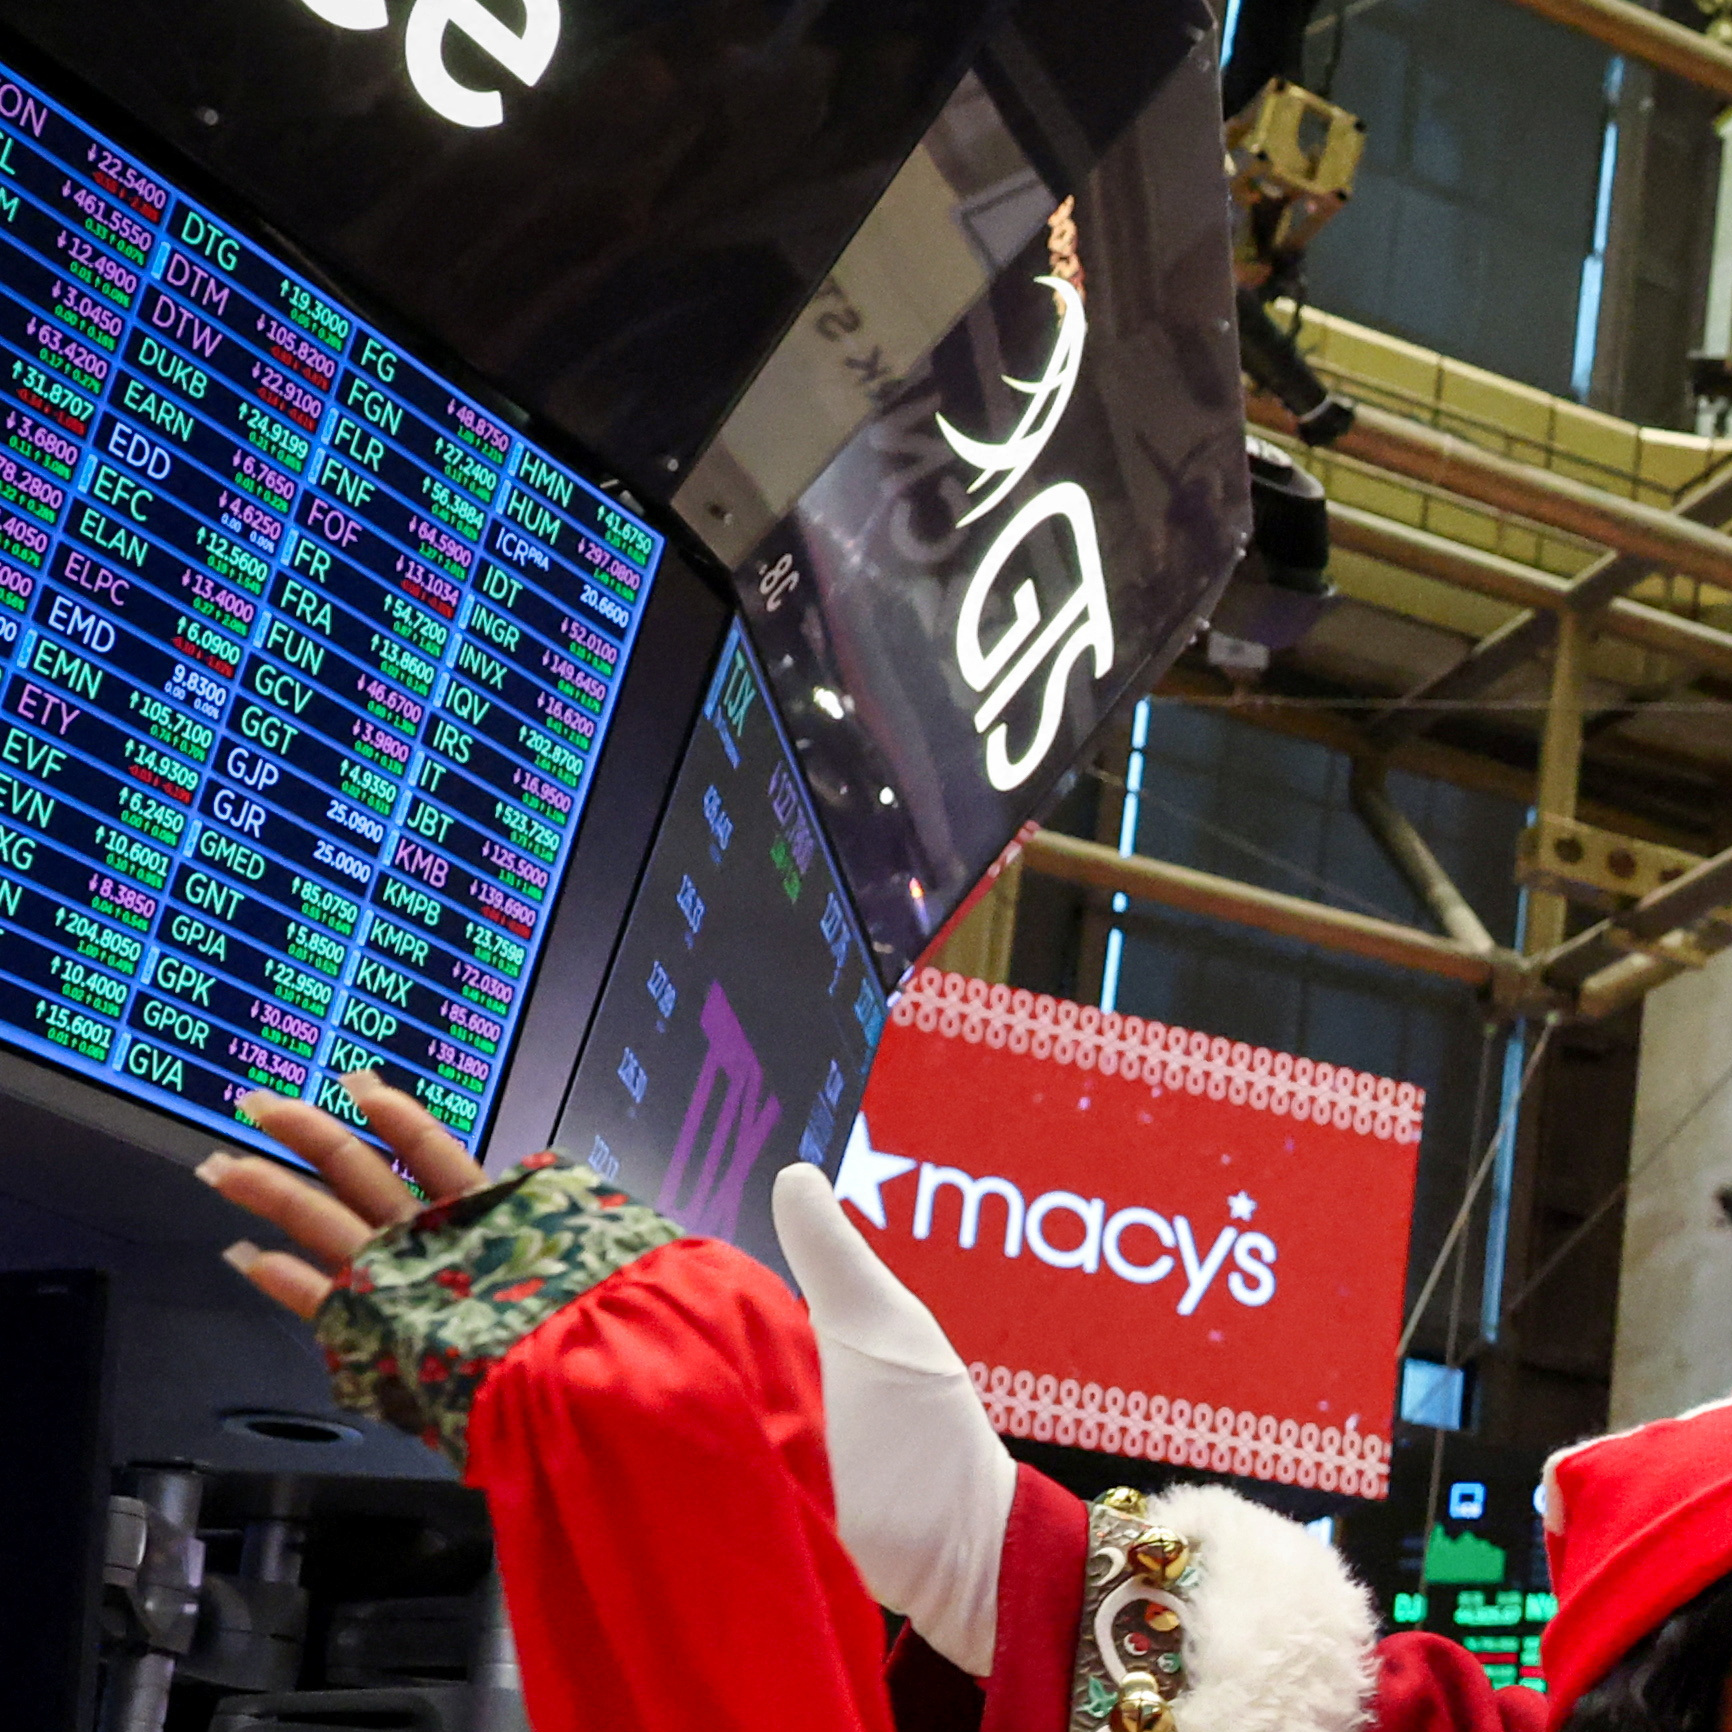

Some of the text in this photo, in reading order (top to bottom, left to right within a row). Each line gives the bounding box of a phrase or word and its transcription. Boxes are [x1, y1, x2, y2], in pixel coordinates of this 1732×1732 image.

[0, 82, 166, 209] ON 22.5400
[68, 237, 137, 294] 12.4900
[73, 189, 151, 251] 461.5550
[63, 286, 122, 336] 3.0450
[166, 253, 335, 378] DTM 105.8200
[181, 211, 349, 339] DTG 19.3000
[22, 366, 94, 421] 31.8707
[38, 325, 107, 379] 63.4200
[152, 295, 322, 419] DTW 22.9100
[360, 338, 509, 452] FG 48.8750
[18, 416, 78, 466] 3.6800
[124, 379, 295, 500] EARN 6.7650
[138, 337, 309, 459] DUKB 24.9199
[347, 378, 497, 491] FGN 27.2400
[109, 422, 281, 540] EDD 4.6250
[321, 458, 472, 567] FNF 64.5900
[334, 417, 485, 530] FLR 56.3884
[507, 489, 561, 545] HUM
[519, 451, 574, 508] HMN
[79, 508, 254, 623] ELAN 13.4000
[93, 465, 268, 582] EFC 12.5600
[307, 498, 459, 607] FOF 13.1034
[64, 551, 129, 606] ELPC
[187, 622, 241, 665] 6.0900
[280, 579, 435, 685] FRA 13.8600
[294, 538, 448, 645] FR 54.7200
[471, 604, 520, 652] INGR
[482, 565, 523, 608] IDT
[33, 639, 213, 749] EMN 105.7100
[48, 595, 115, 652] EMD
[172, 664, 226, 706] 9.8300
[267, 620, 422, 723] FUN 46.6700
[458, 642, 508, 689] INVX
[17, 683, 199, 791] ETY 14.9309
[255, 664, 409, 763] GCV 3.9800
[433, 720, 473, 764] IRS
[445, 681, 490, 725] IQV
[2, 728, 185, 833] EVF 6.2450
[227, 747, 384, 843] GJP 25.0900
[241, 705, 397, 803] GGT 4.9350
[420, 759, 447, 792] IT
[104, 830, 169, 877] 10.6001
[213, 789, 371, 883] GJR 25.0000
[394, 838, 449, 888] KMB
[406, 802, 454, 843] JBT
[99, 878, 156, 918] 8.3850
[185, 872, 345, 964] GNT 5.8500
[200, 830, 358, 924] GMED 85.0750
[382, 877, 441, 926] KMPB
[60, 960, 128, 1004] 10.4000
[64, 912, 142, 962] 204.8050
[171, 914, 332, 1005] GPJA 22.9500
[370, 918, 429, 967] KMPR
[45, 1004, 112, 1049] 15.6001
[157, 957, 319, 1045] GPK 30.0050
[343, 998, 397, 1042] KOP
[356, 958, 414, 1008] KMX
[128, 1043, 183, 1092] GVA
[143, 1000, 306, 1085] GPOR 178.3400
